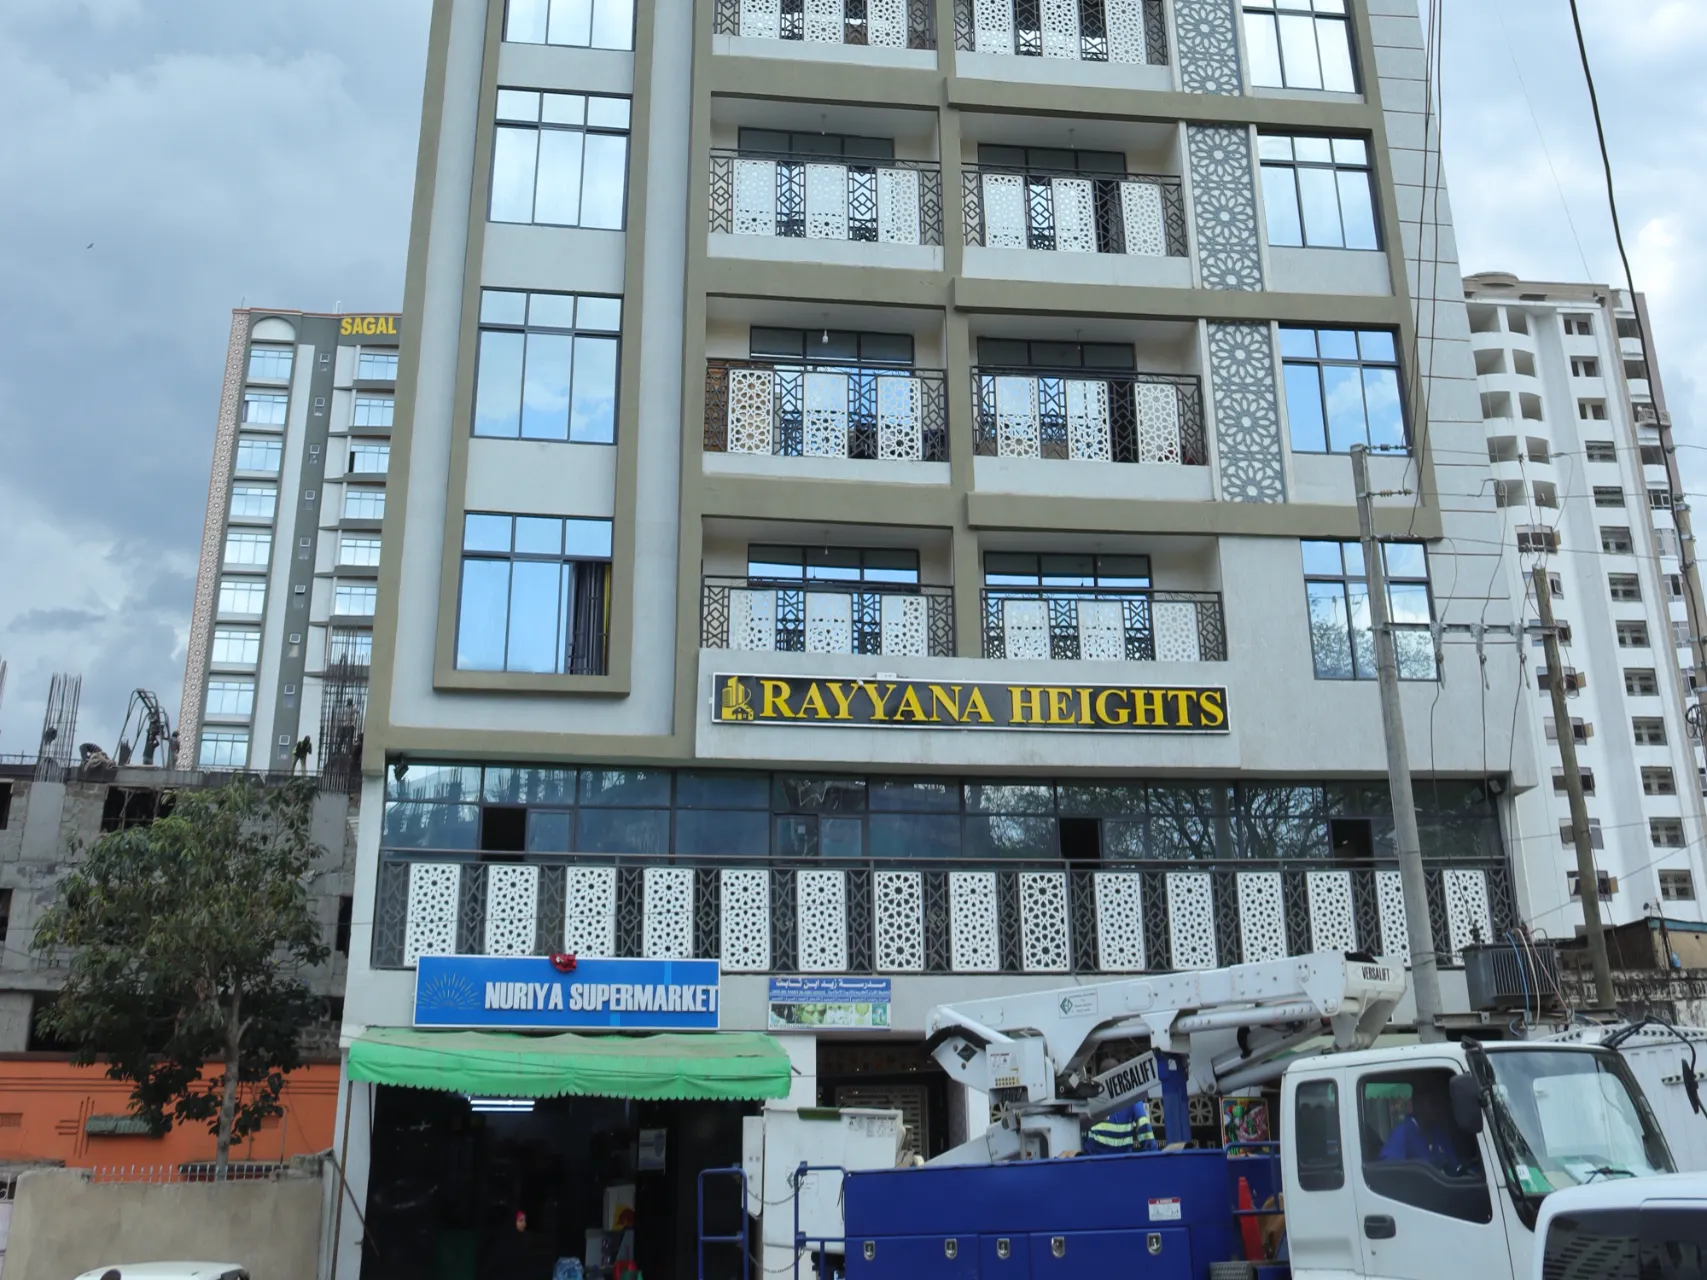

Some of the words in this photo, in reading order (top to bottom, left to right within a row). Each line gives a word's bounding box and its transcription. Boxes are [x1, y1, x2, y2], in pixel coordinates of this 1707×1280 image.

[341, 316, 397, 336] SAGAL
[760, 680, 994, 723] RAYYANA
[1007, 687, 1224, 727] HEIGHTS
[1361, 965, 1391, 982] VERSALIFT
[485, 982, 563, 1010] NURIYA
[569, 984, 719, 1012] SUPERMARKET
[1105, 1057, 1156, 1099] VERSALIFT
